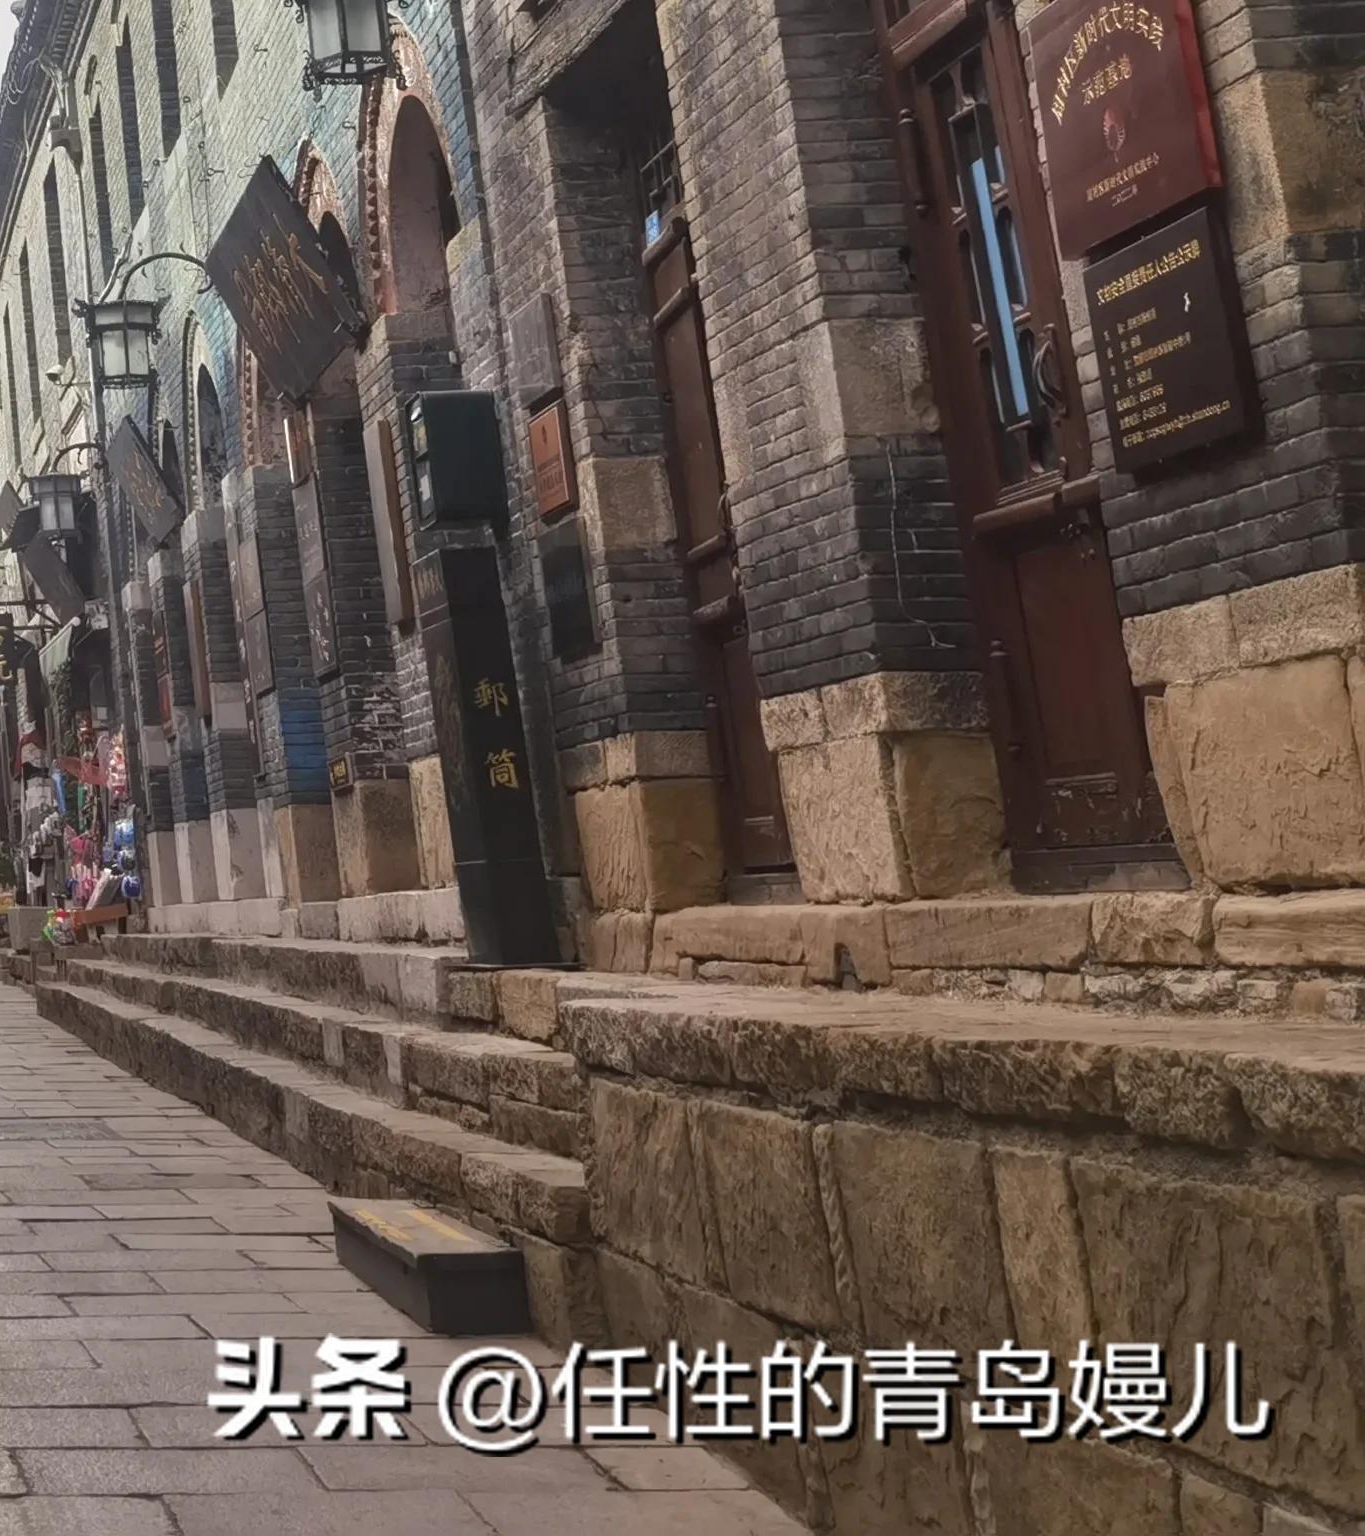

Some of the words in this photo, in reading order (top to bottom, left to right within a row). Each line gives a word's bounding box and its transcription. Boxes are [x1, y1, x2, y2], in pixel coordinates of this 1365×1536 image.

[1081, 53, 1133, 105] 示范基地
[472, 675, 520, 790] 郵筒
